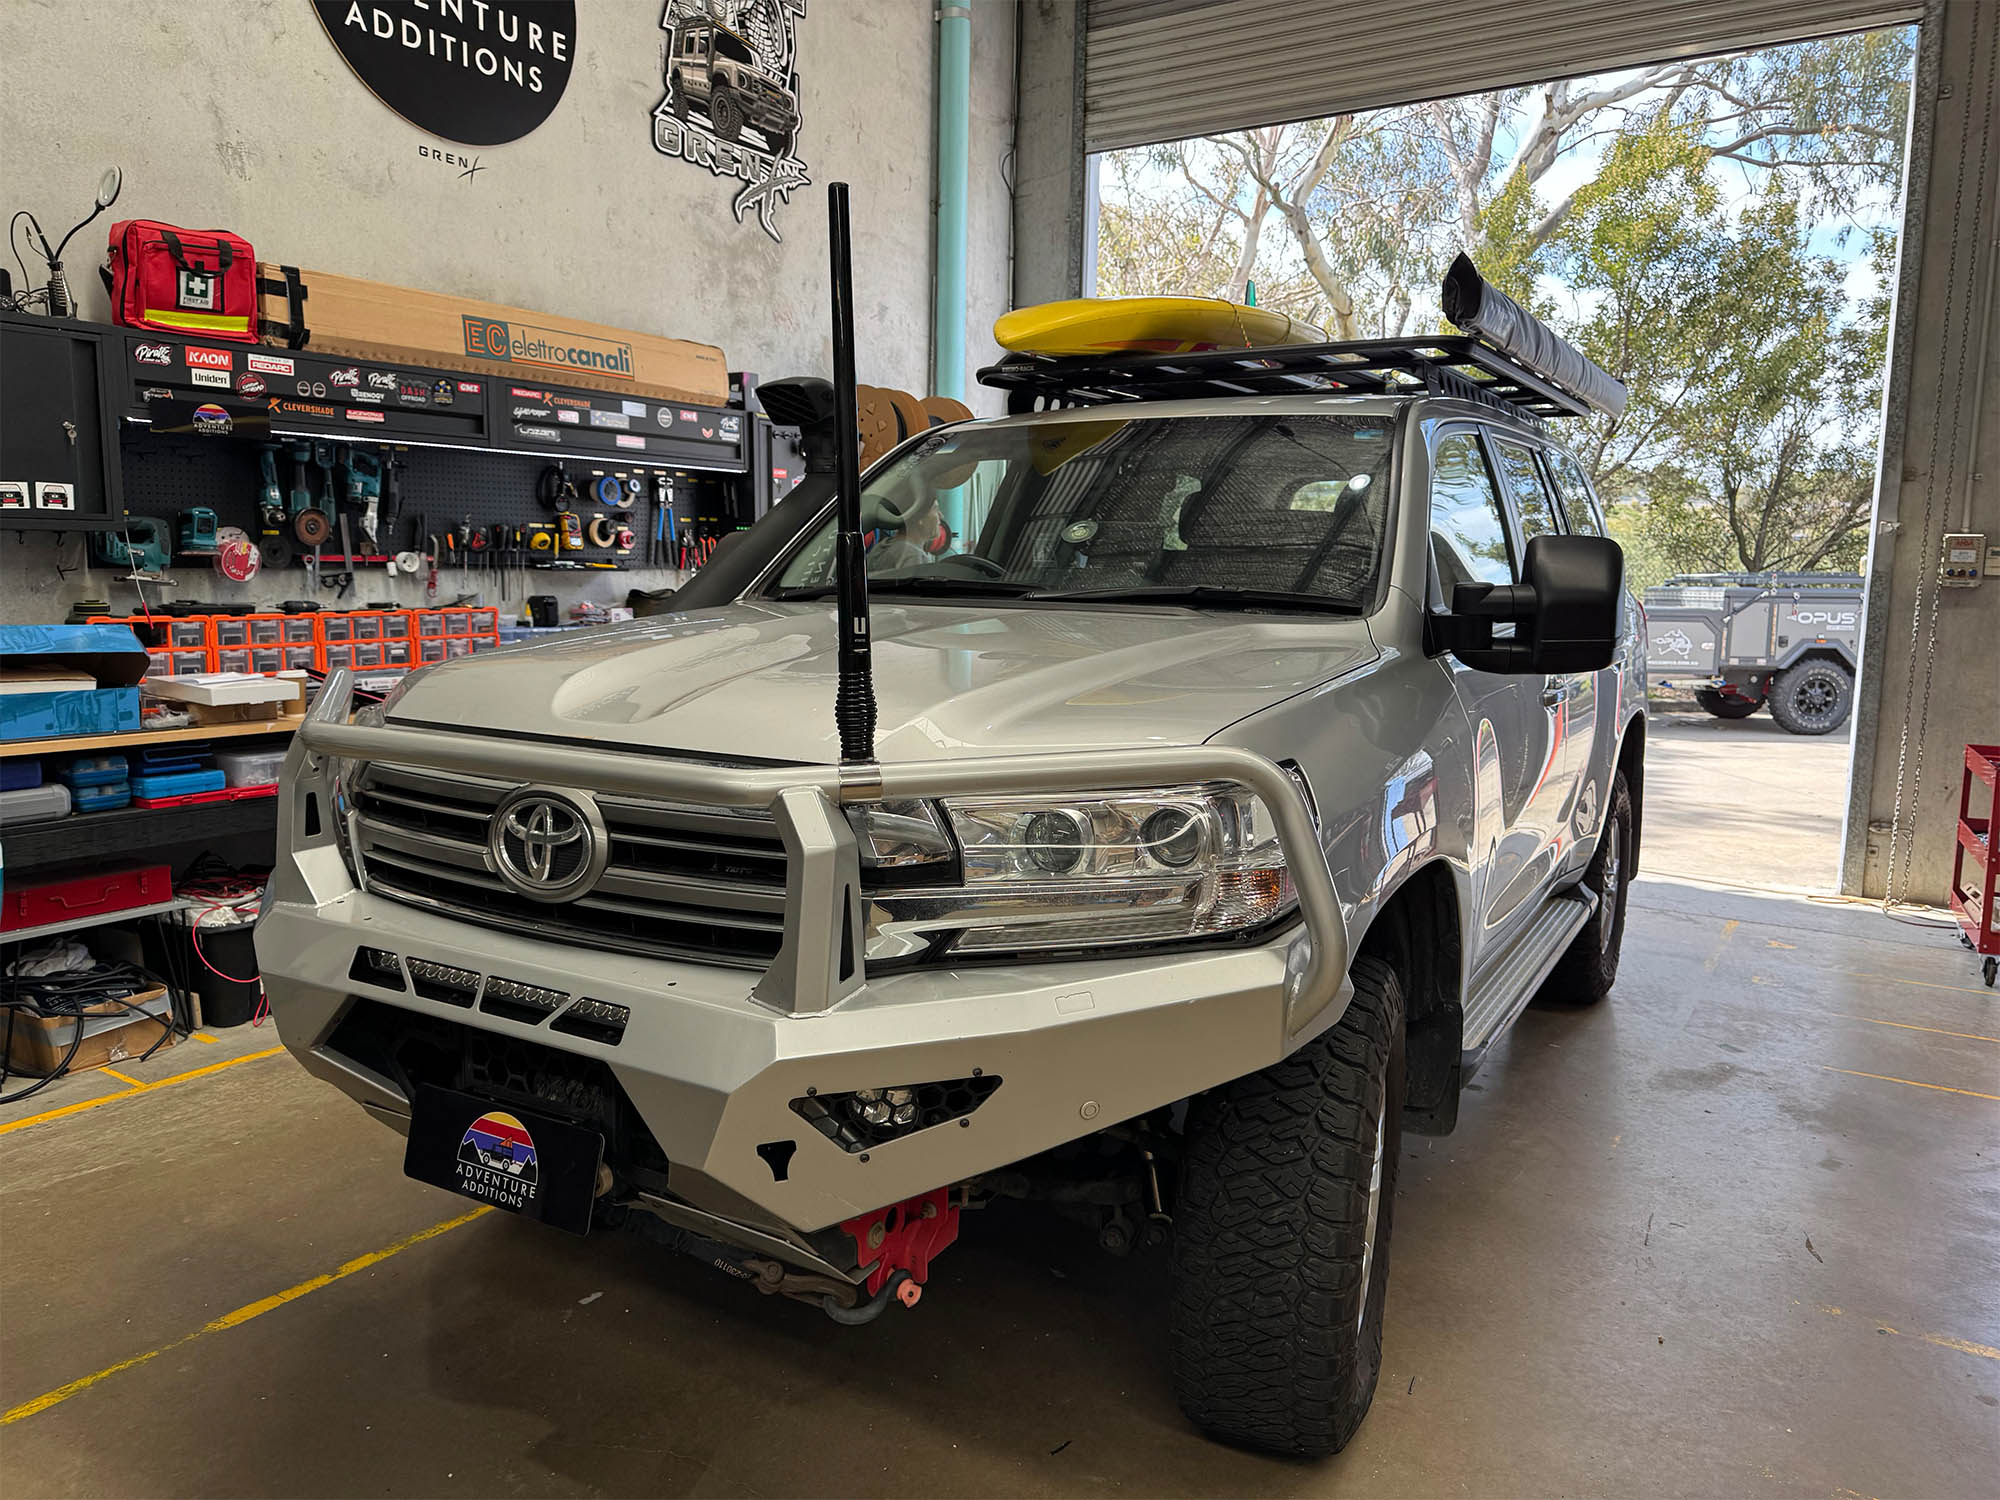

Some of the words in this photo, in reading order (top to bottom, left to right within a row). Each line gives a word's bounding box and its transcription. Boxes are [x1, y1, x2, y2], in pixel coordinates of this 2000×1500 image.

[344, 1, 543, 93] ADDITIONS
[183, 297, 199, 305] FIRST
[465, 319, 507, 356] EC
[512, 330, 631, 372] elettrocanali
[189, 351, 229, 367] KAON
[252, 361, 290, 372] REDARC
[194, 372, 228, 384] Uniden
[400, 384, 425, 396] DASH
[283, 402, 335, 415] CLEVERSHADE
[193, 423, 232, 431] ADVENTURE
[1798, 612, 1855, 624] OPUS
[455, 1163, 537, 1199] ADVENTURE
[461, 1179, 523, 1208] ADDITIONS
